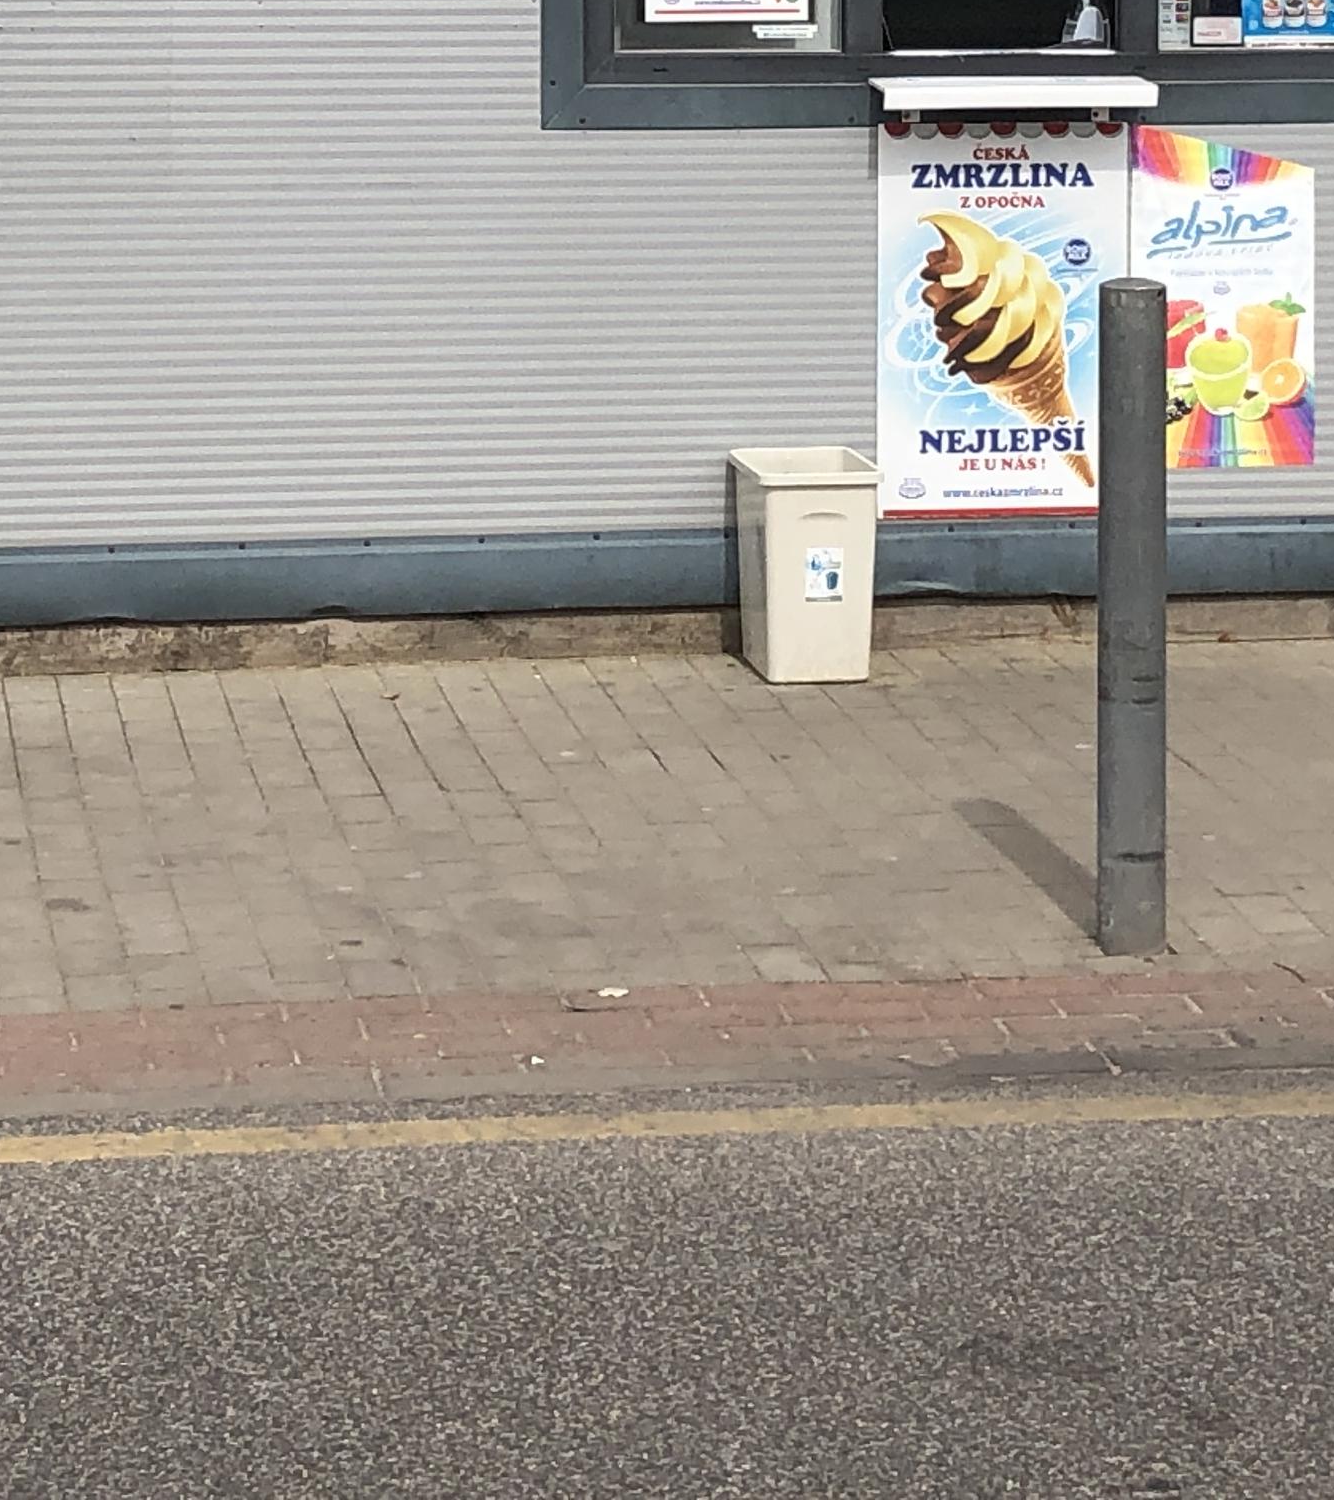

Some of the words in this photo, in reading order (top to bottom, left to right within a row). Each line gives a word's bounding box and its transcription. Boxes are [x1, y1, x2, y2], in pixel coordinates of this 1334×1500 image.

[972, 143, 1030, 160] ČESKÁ
[911, 163, 1095, 190] ZMRZLINA
[960, 195, 973, 209] Z
[976, 192, 1046, 209] OPOČNA
[1151, 199, 1290, 249] alpina
[919, 419, 1086, 454] NEJLEPŠÍ
[958, 458, 981, 471] JE
[984, 458, 997, 471] U
[1001, 455, 1038, 471] NÁS
